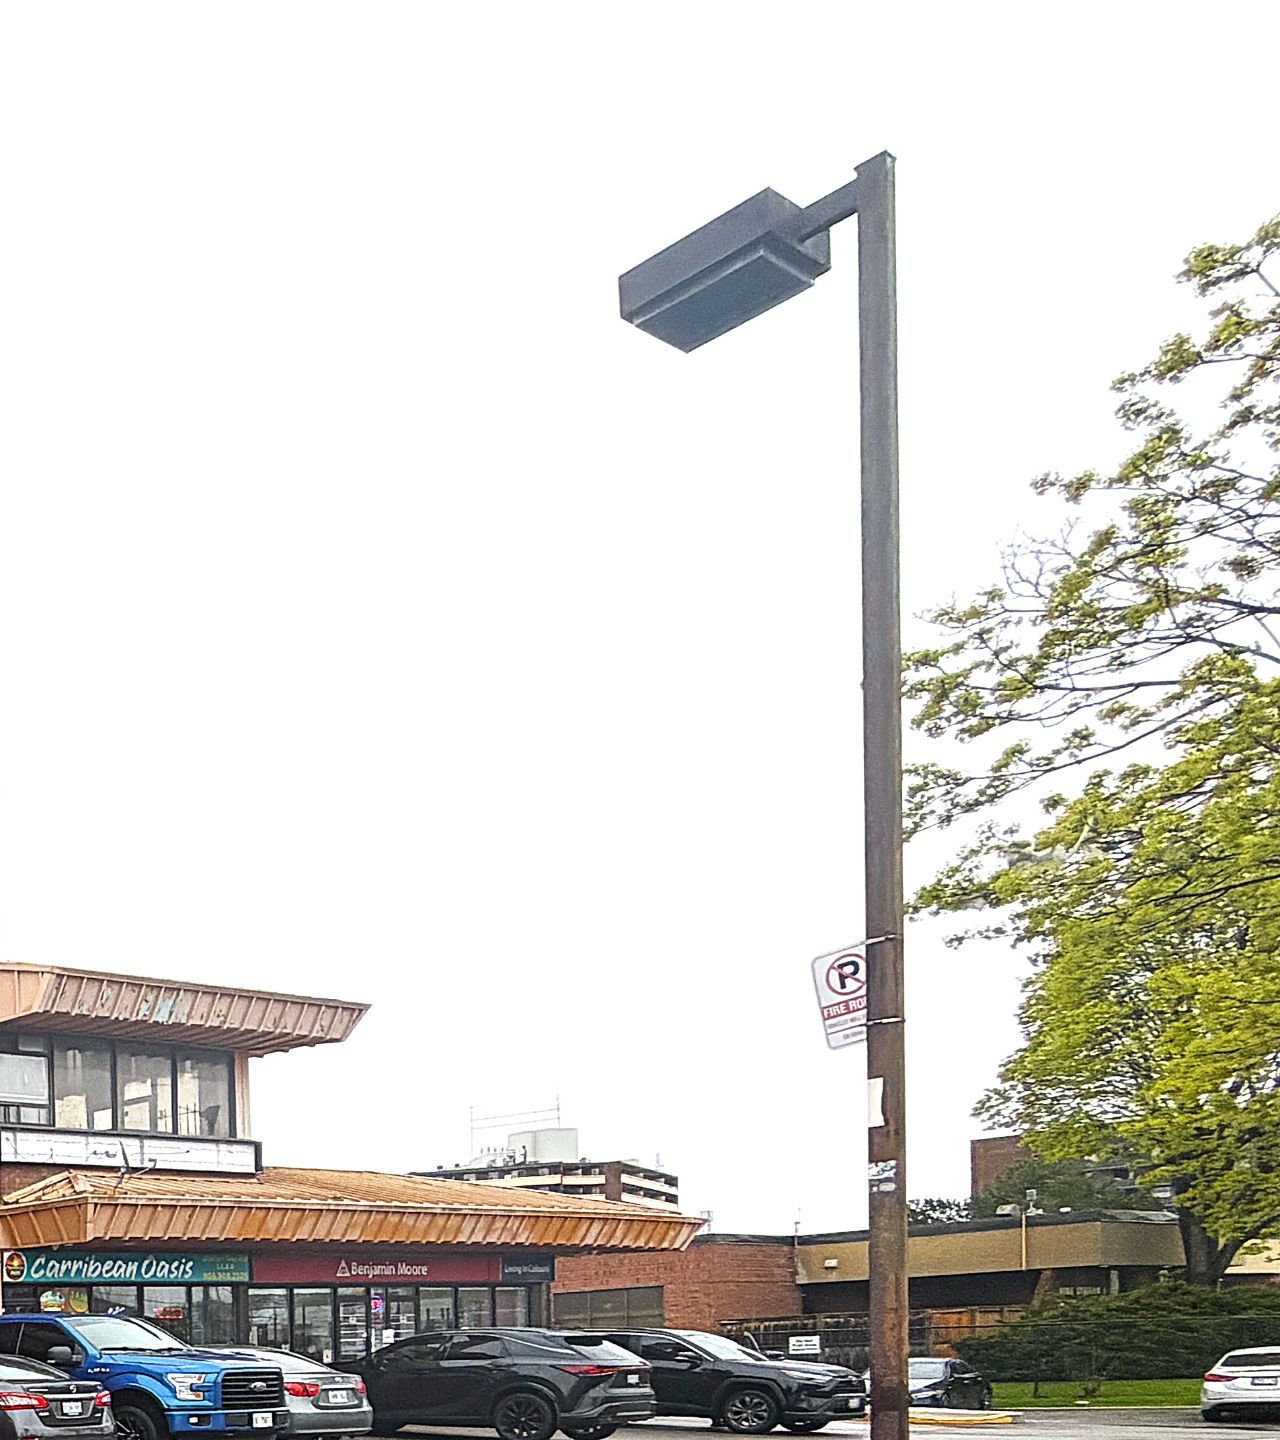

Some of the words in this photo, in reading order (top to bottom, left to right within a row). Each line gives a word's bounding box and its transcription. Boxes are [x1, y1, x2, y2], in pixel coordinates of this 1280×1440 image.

[823, 1002, 848, 1018] FIRE
[31, 1255, 137, 1279] Carribean
[142, 1257, 193, 1279] Oasis
[351, 1262, 395, 1277] Benjamin
[397, 1262, 428, 1276] Moore
